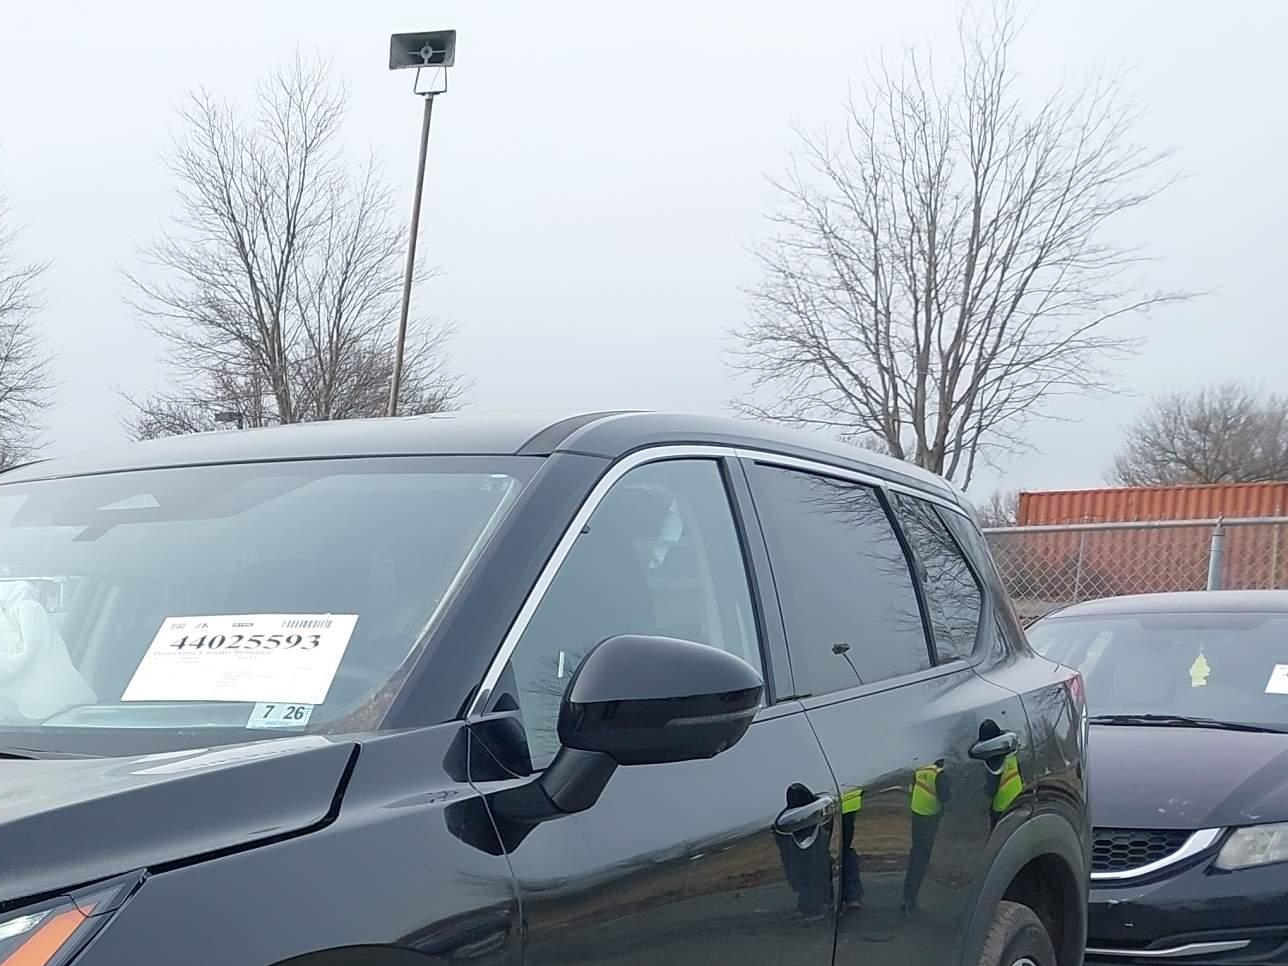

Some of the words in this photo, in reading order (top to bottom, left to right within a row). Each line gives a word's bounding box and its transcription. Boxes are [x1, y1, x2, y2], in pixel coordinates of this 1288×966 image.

[169, 633, 322, 651] 44025593
[262, 704, 276, 719] 7
[282, 705, 306, 721] 26
